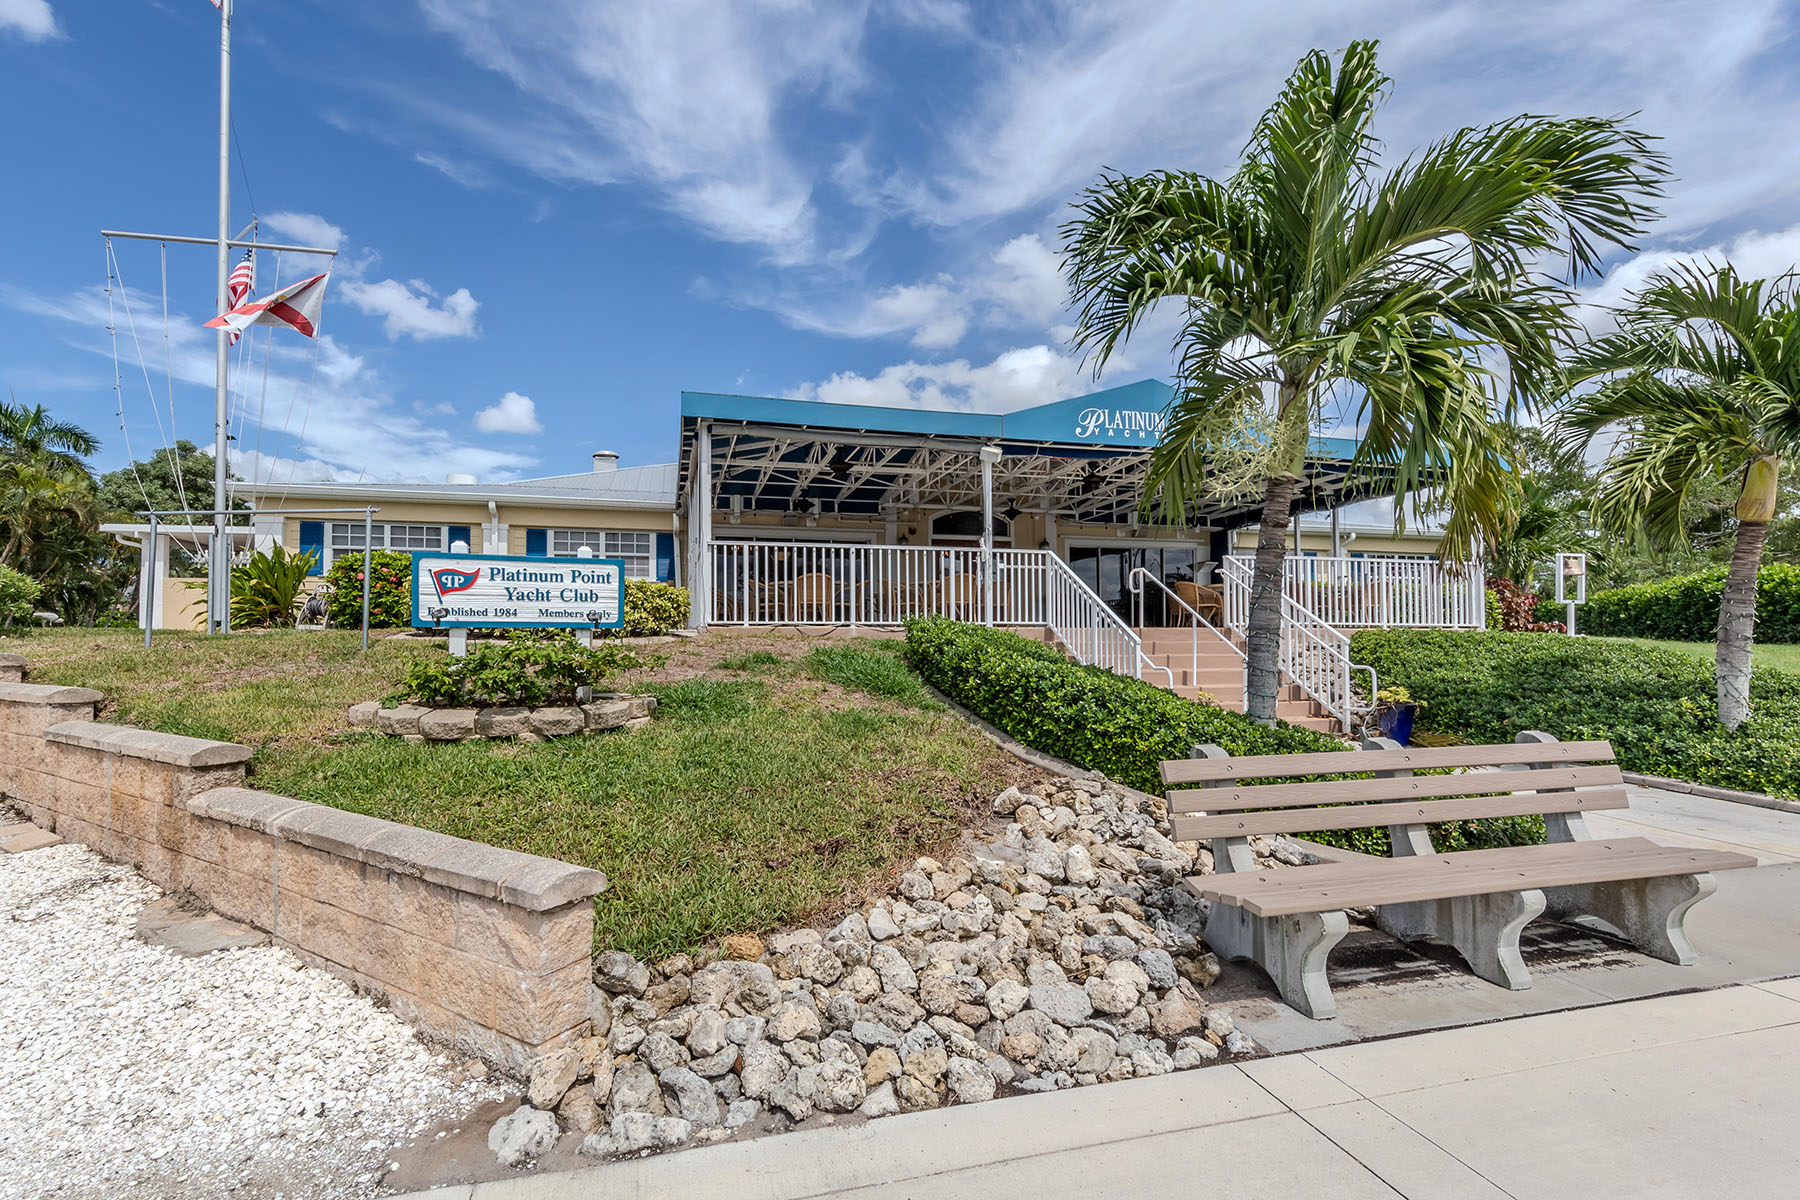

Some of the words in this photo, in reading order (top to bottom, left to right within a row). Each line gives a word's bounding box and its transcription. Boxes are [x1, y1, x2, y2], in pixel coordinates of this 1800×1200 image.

[1075, 408, 1165, 438] PLATINUM
[1094, 428, 1160, 439] YACHT
[488, 567, 564, 583] Platinum
[571, 569, 612, 584] Point
[504, 587, 551, 602] Yacht
[560, 588, 599, 603] Club
[427, 606, 488, 617] Eblished
[492, 607, 518, 617] 1984
[538, 608, 584, 618] Members
